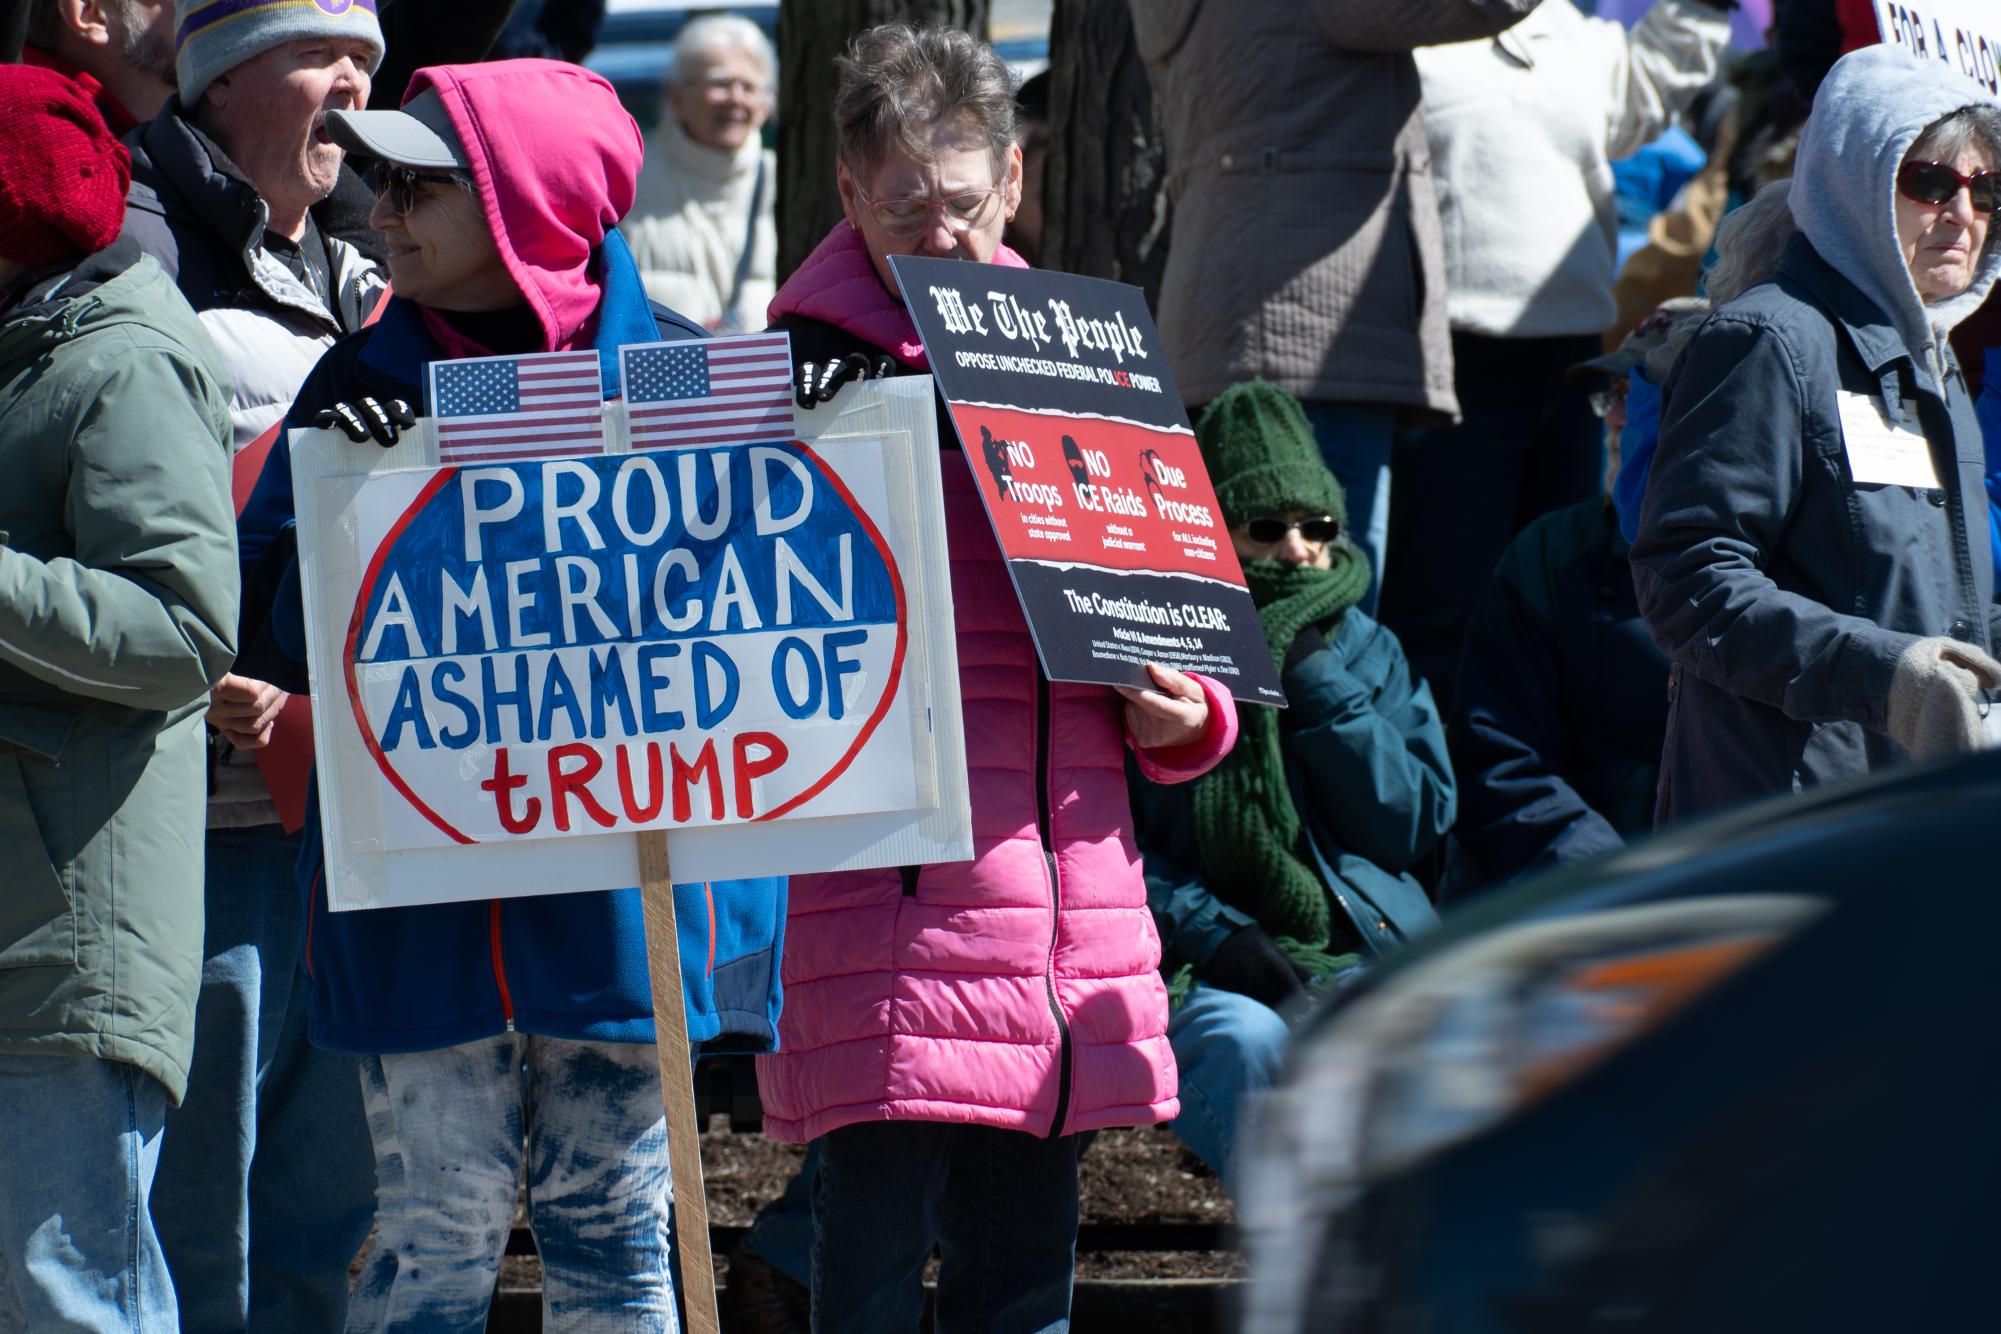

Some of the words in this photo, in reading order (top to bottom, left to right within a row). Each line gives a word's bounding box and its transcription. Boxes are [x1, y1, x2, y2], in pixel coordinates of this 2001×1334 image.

[1888, 2, 1928, 58] FOR
[1933, 18, 1949, 64] A
[929, 285, 988, 336] We
[987, 290, 1051, 352] The
[1048, 298, 1148, 364] People
[955, 351, 999, 370] OPPOSE
[996, 355, 1058, 377] UNCHECKED
[1056, 361, 1099, 383] FEDERAL
[1098, 367, 1131, 388] POLICE
[1130, 372, 1162, 394] POWER
[1006, 441, 1035, 469] NO
[1082, 449, 1111, 478] NO
[1152, 458, 1187, 488] Due
[459, 446, 814, 562] PROUD
[1001, 475, 1063, 512] Troops
[1072, 482, 1105, 513] ICE
[1101, 486, 1148, 518] Raids
[1153, 493, 1214, 528] Process
[1020, 512, 1029, 523] in
[1028, 513, 1045, 525] cities
[1044, 515, 1068, 528] without
[1028, 528, 1045, 539] state
[1044, 530, 1072, 542] approval
[1106, 522, 1129, 536] without
[1127, 527, 1134, 536] a
[1101, 535, 1124, 549] judicial
[1172, 530, 1182, 542] for
[1181, 532, 1194, 544] ALL
[1191, 533, 1217, 550] including
[359, 533, 854, 662] AMERICAN
[1063, 589, 1094, 615] The
[1091, 592, 1171, 626] Constitution
[1167, 602, 1184, 627] is
[1181, 604, 1231, 632] CLEAR:
[1141, 632, 1181, 648] Amendments
[1180, 637, 1188, 651] 4,
[1186, 637, 1195, 651] 5,
[1193, 638, 1204, 650] 14
[379, 640, 740, 752] ASHAMED
[771, 628, 869, 721] OF
[481, 731, 789, 835] tRUMP
